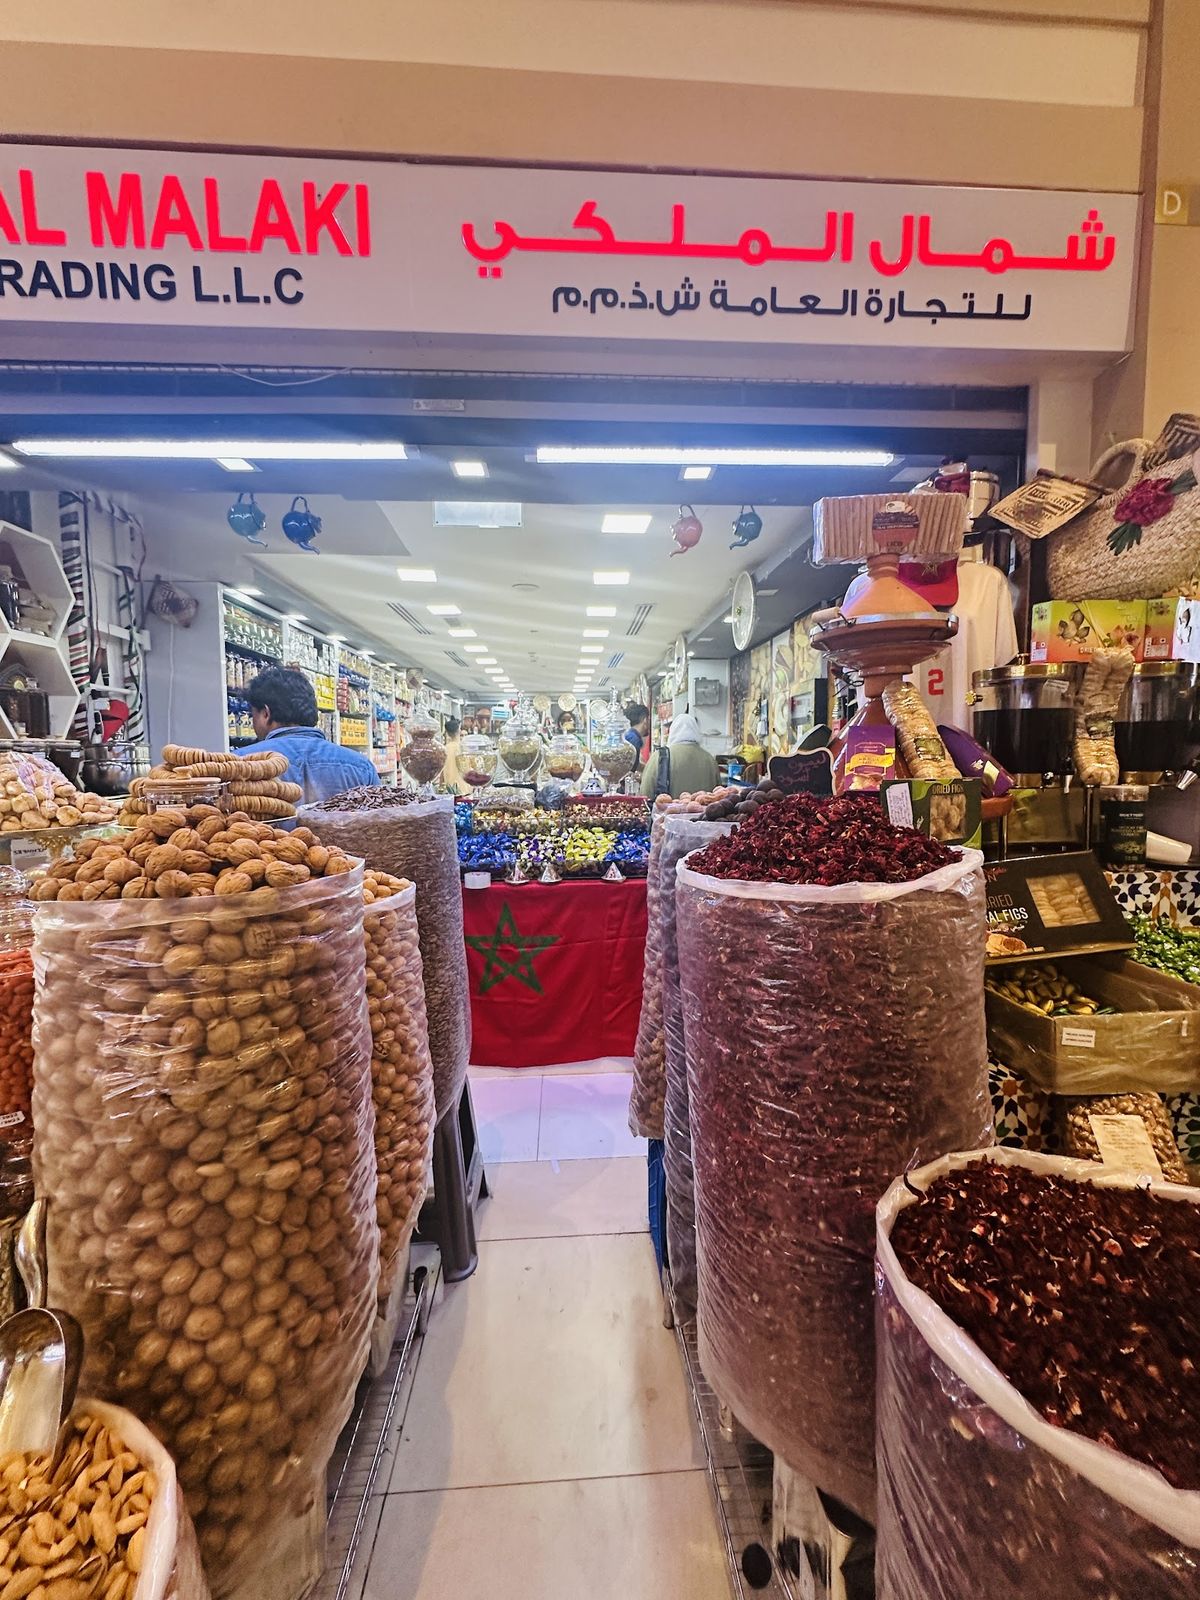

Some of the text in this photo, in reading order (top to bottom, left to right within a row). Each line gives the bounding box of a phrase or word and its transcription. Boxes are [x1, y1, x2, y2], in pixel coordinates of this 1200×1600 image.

[85, 171, 371, 257] MALAKI
[1163, 190, 1182, 216] D
[461, 201, 1116, 279] شمال الملكي
[193, 265, 305, 306] L.L.C
[709, 279, 859, 318] العامة
[864, 288, 1033, 325] للتجارة
[928, 669, 944, 696] 2
[932, 784, 950, 794] DRIED
[1001, 907, 1029, 921] FIGS
